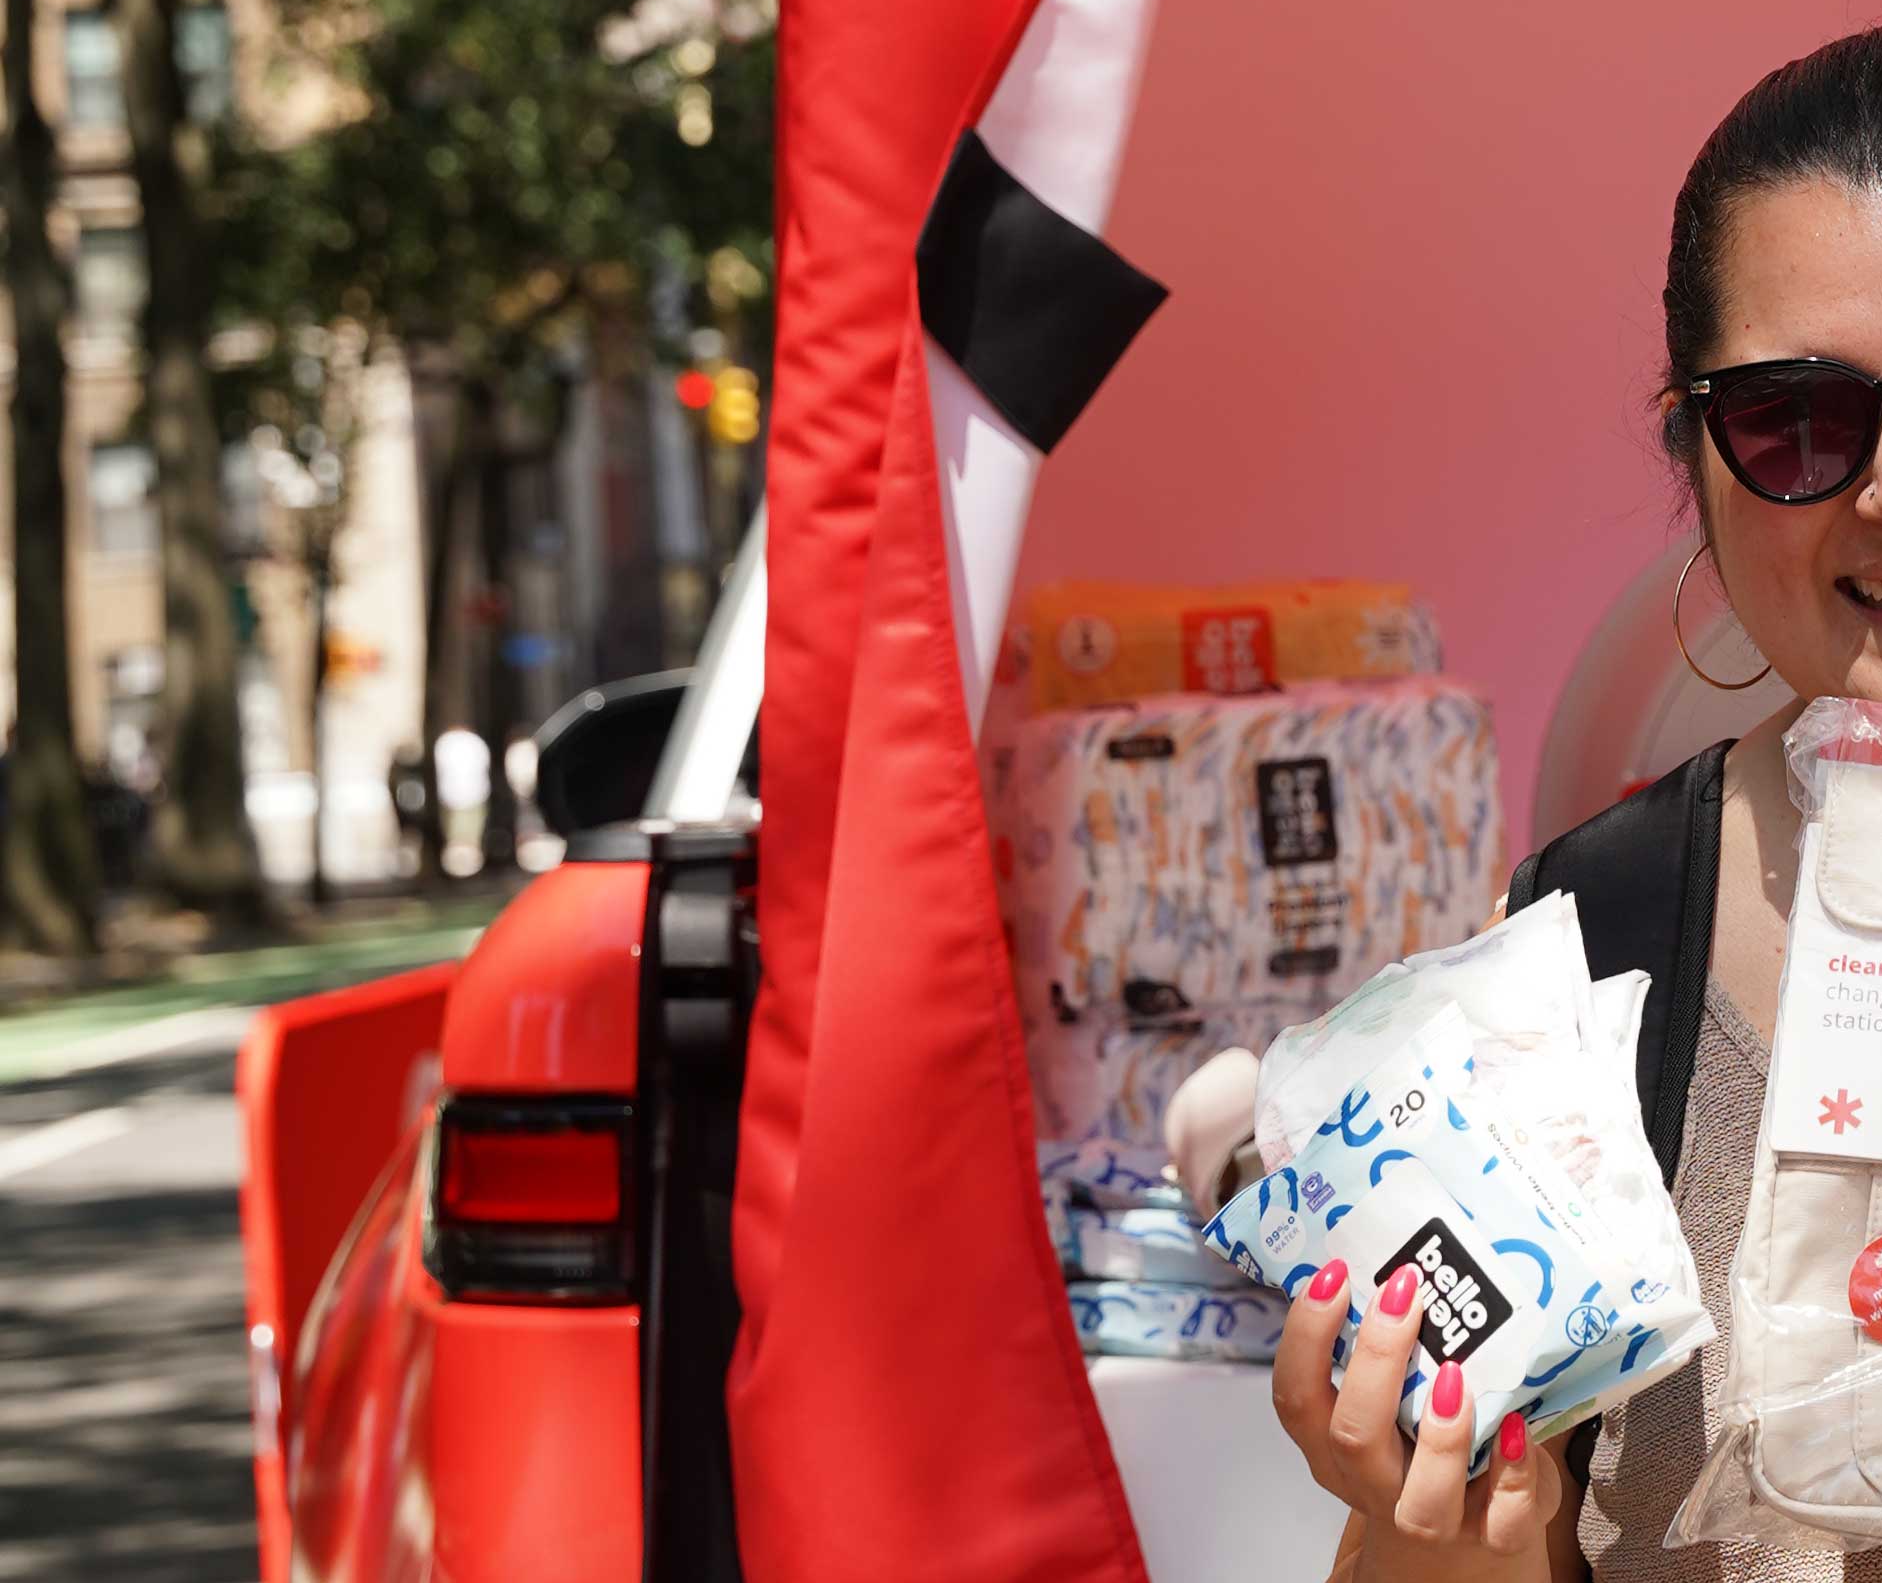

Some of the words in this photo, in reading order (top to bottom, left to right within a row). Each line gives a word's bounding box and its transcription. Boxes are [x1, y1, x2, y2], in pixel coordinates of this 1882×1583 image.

[1389, 1089, 1426, 1129] 20
[1273, 1227, 1300, 1254] WATER
[1415, 1234, 1488, 1329] bello
